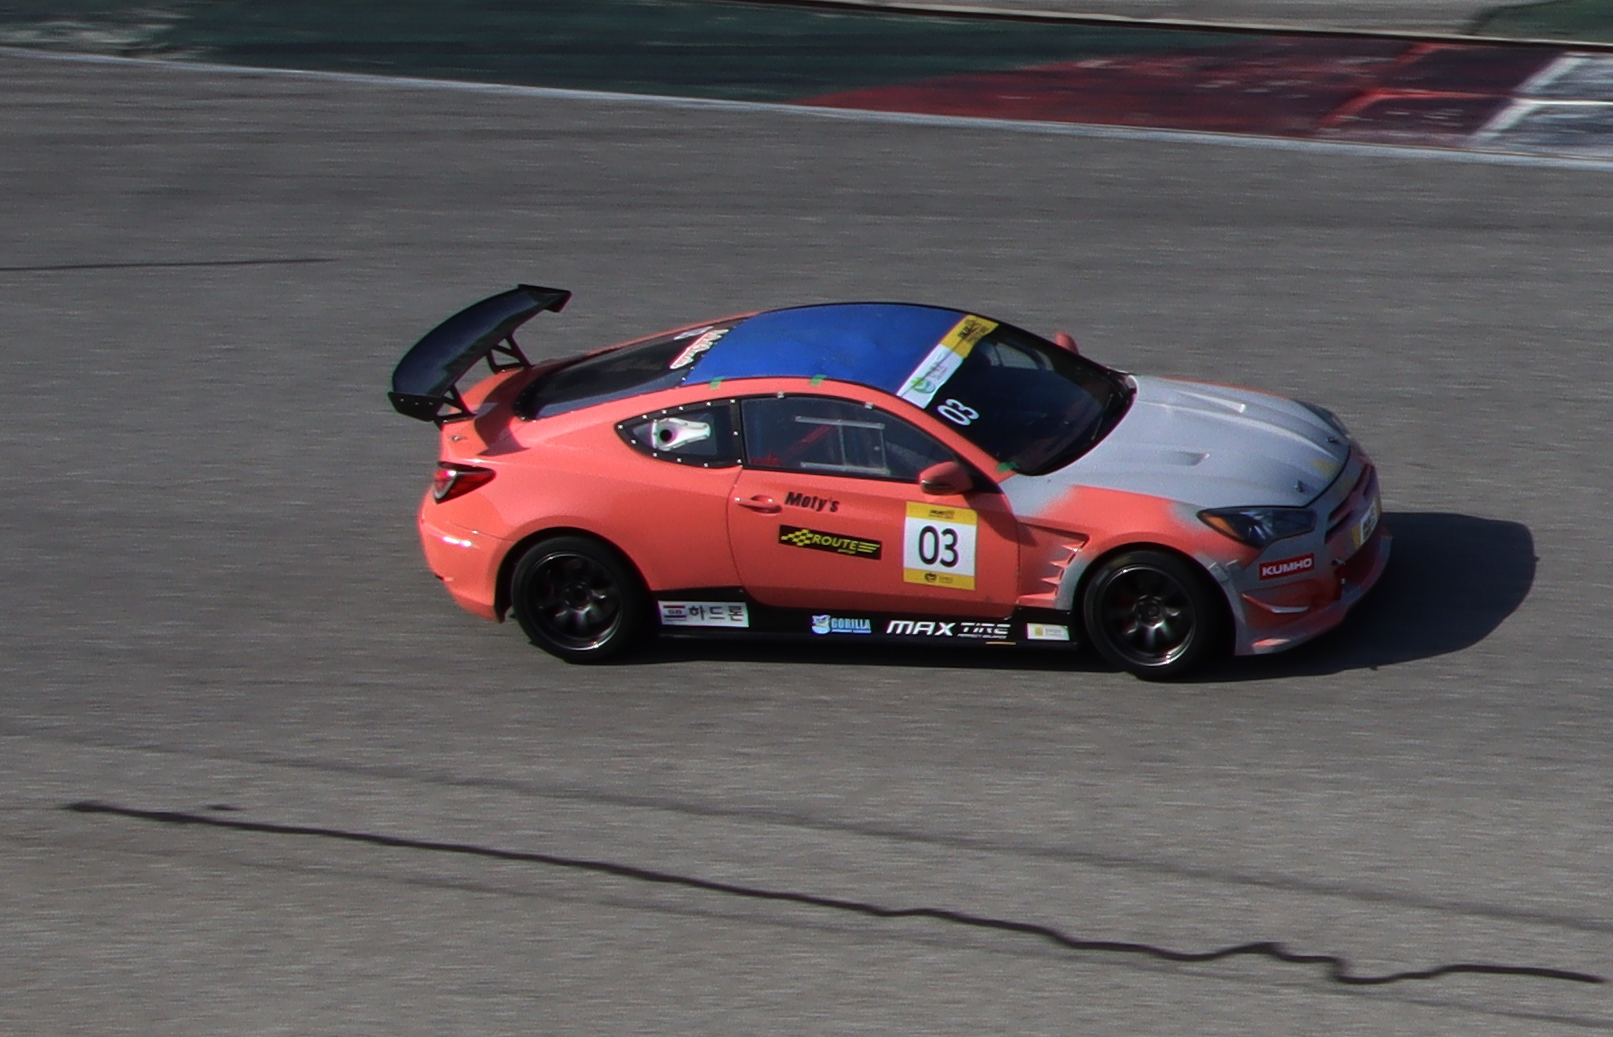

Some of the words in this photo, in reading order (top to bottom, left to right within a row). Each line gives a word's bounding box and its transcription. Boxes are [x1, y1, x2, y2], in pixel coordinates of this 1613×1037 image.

[937, 398, 980, 426] 03
[784, 491, 840, 513] Moty's
[811, 534, 859, 551] ROUTE
[918, 525, 959, 568] 03
[1262, 557, 1313, 576] KUMHO
[831, 617, 871, 629] GORILLA
[886, 620, 956, 636] MAX
[960, 622, 1011, 635] TIRE
